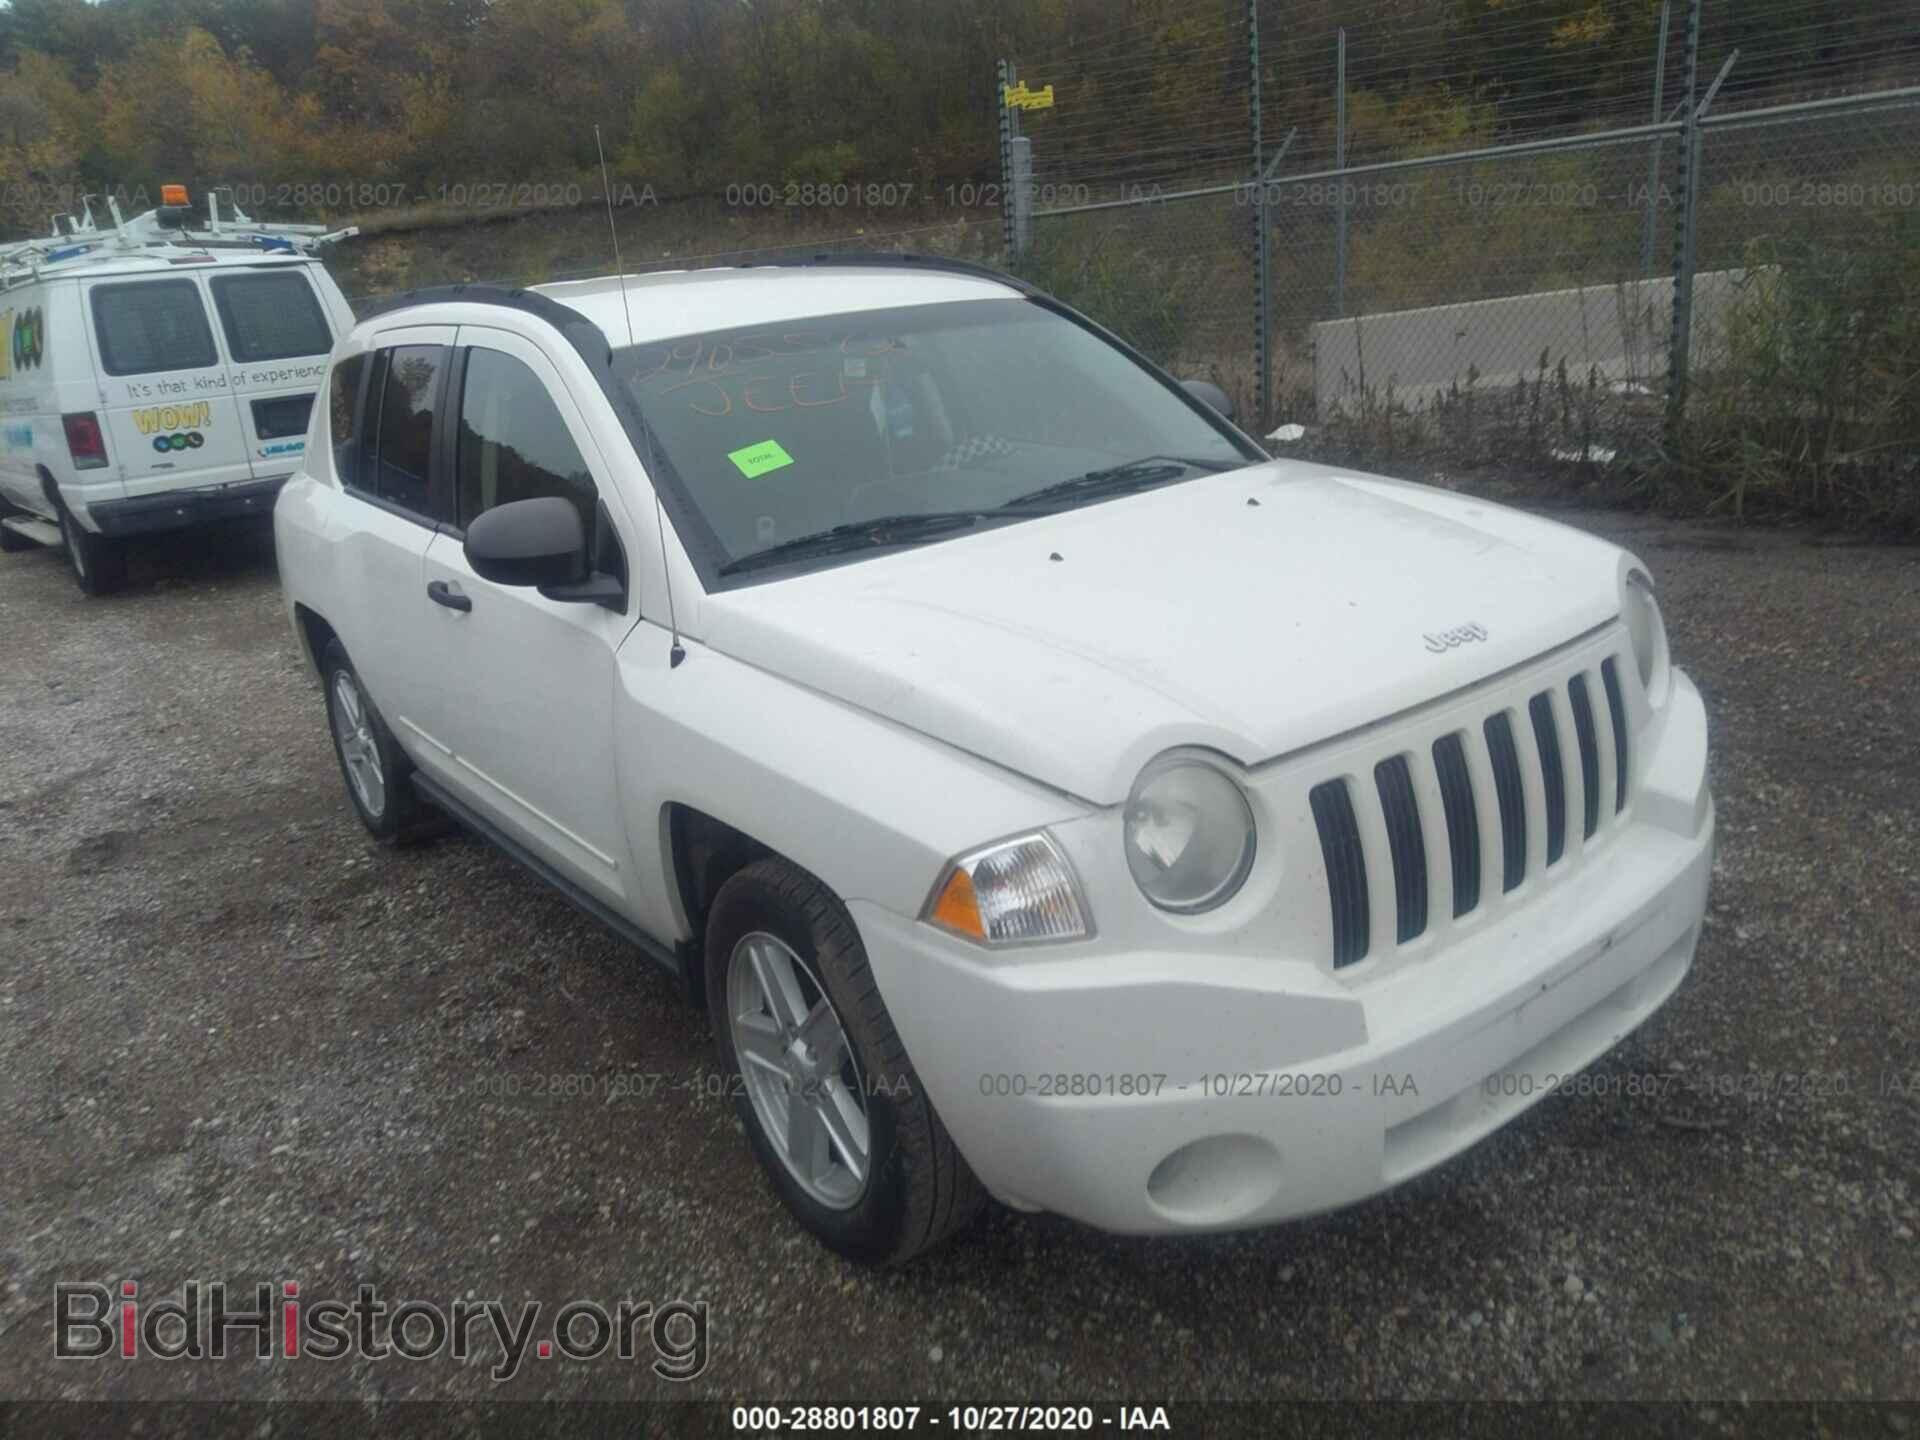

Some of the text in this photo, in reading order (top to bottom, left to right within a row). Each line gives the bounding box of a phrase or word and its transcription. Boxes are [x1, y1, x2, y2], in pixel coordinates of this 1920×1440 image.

[126, 383, 153, 399] It's
[157, 379, 188, 395] that
[192, 373, 227, 389] kind
[232, 370, 249, 387] of
[131, 400, 212, 435] WOW!
[1422, 622, 1488, 653] Jeep
